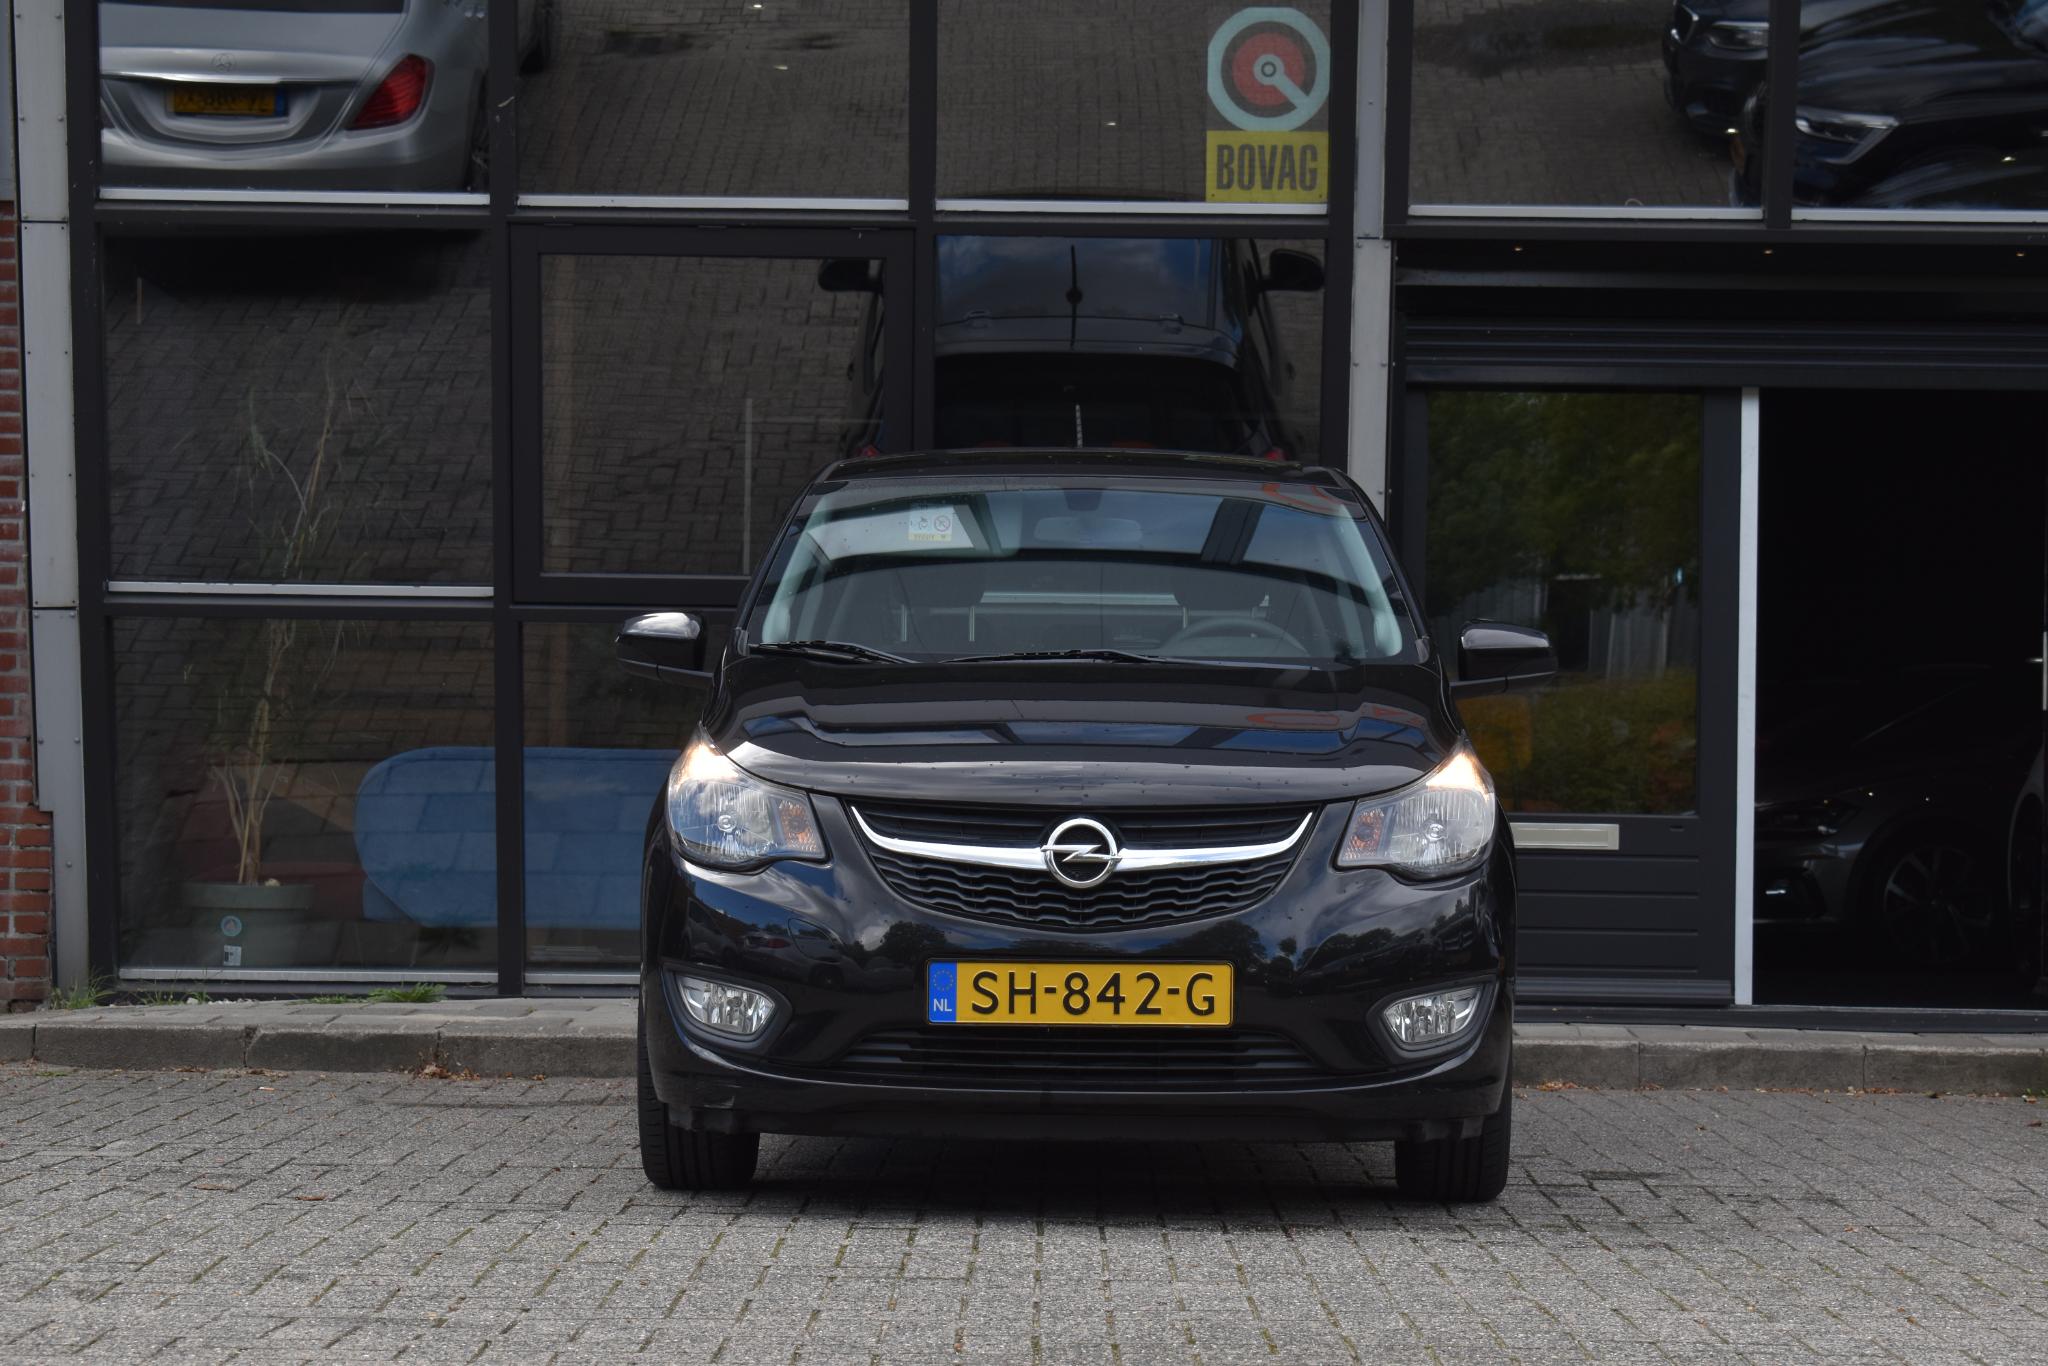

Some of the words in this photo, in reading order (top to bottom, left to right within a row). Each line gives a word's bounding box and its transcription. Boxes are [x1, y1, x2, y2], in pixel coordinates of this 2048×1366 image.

[1216, 144, 1319, 192] BOVAG
[933, 998, 953, 1012] NL
[971, 970, 1216, 1016] SH-842-G
